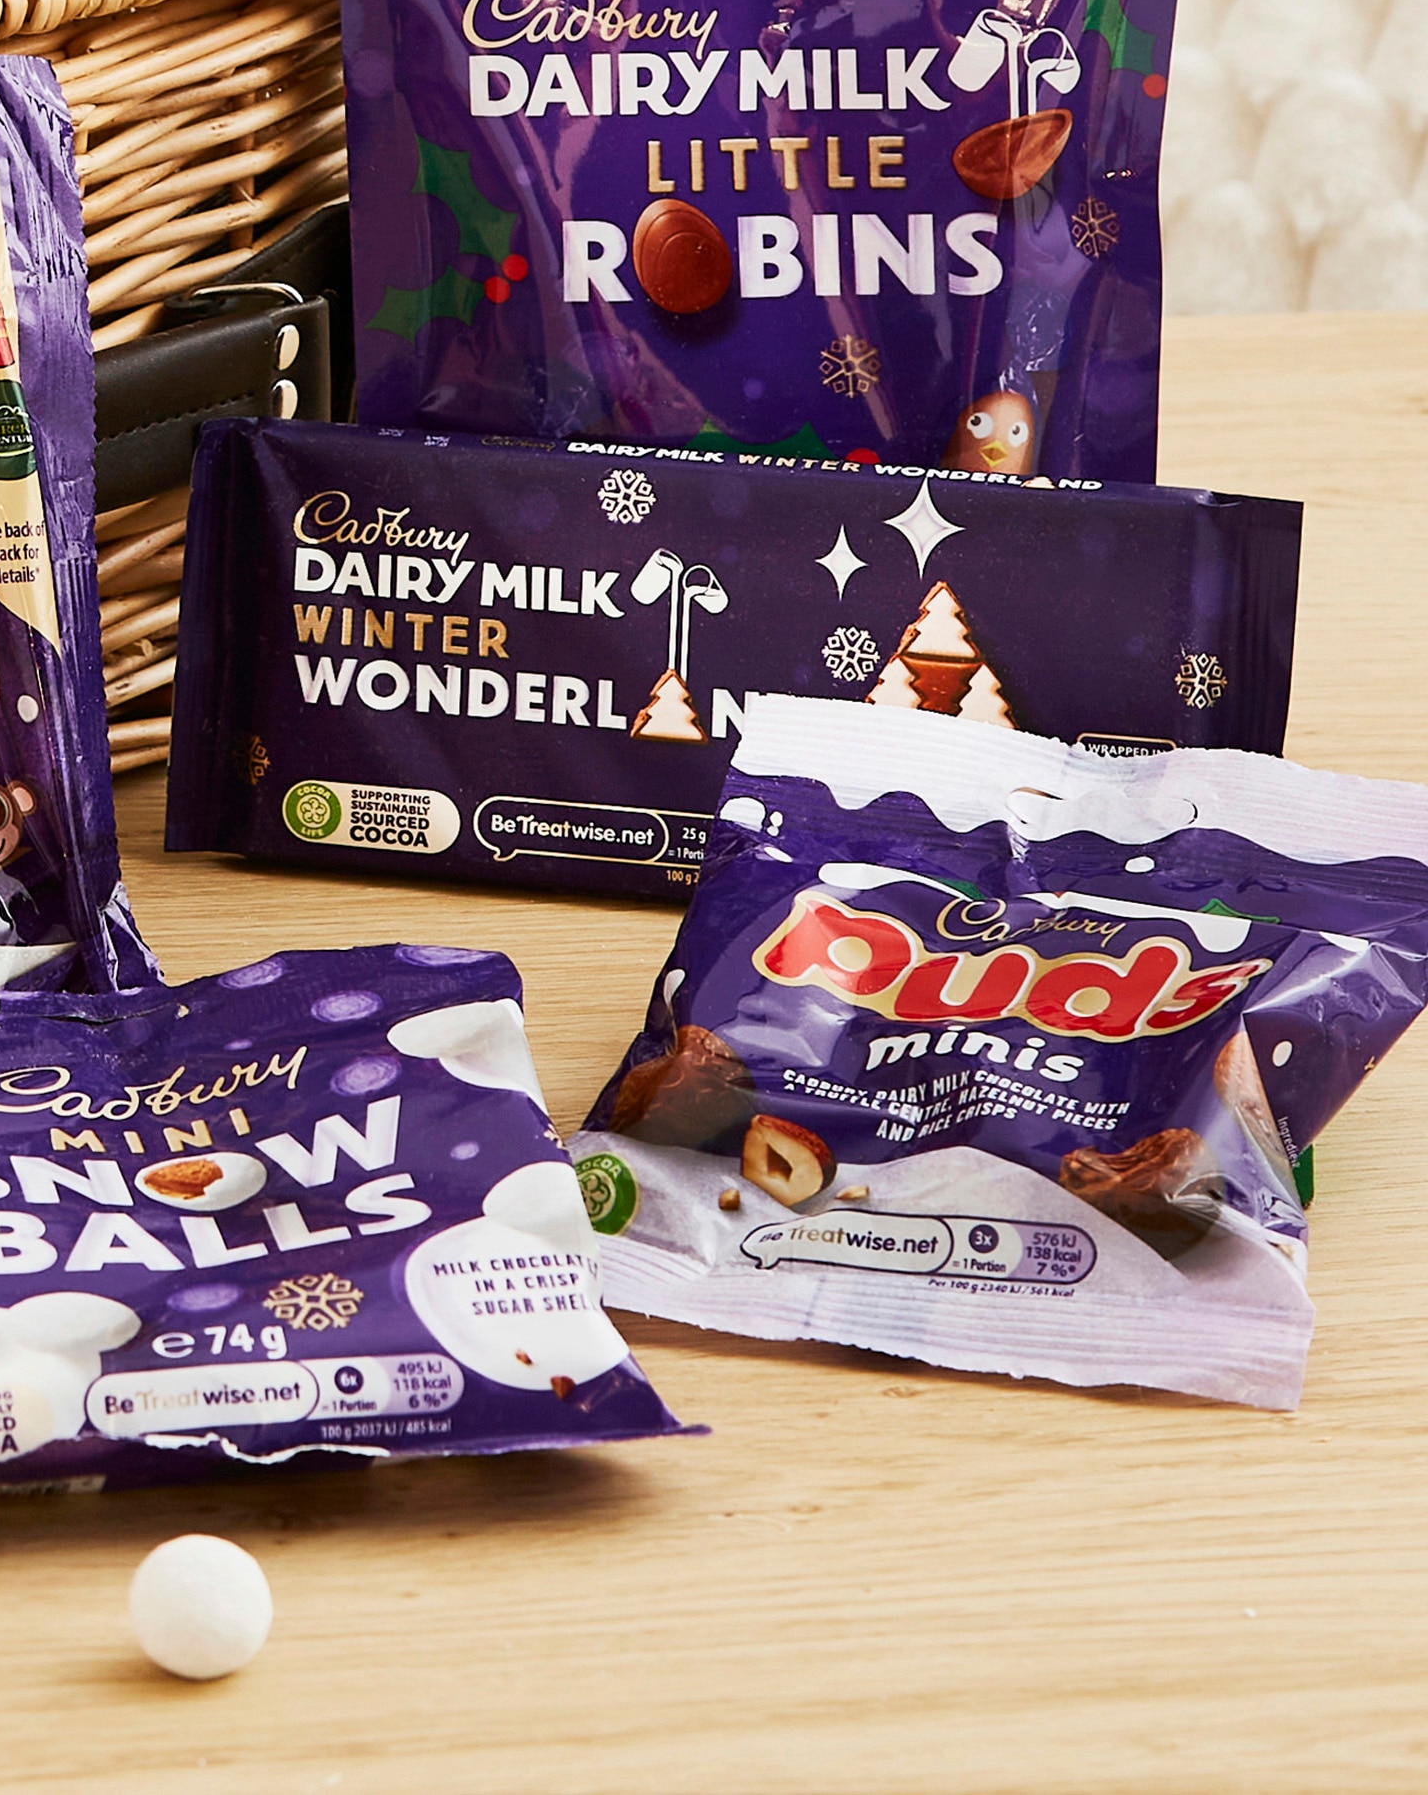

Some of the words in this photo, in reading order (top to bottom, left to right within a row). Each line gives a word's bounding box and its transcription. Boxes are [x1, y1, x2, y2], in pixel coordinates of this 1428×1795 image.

[469, 48, 729, 117] DAIRY
[739, 46, 951, 112] MILK
[647, 134, 907, 193] LITTLE
[566, 441, 656, 457] DAIRY
[655, 447, 725, 463] MILK
[739, 454, 862, 472] WINTER
[4, 521, 33, 538] back
[293, 490, 470, 564] Cadbury
[23, 543, 39, 559] for
[294, 548, 475, 603] DAIRY
[481, 563, 625, 618] MILK
[293, 604, 510, 659] WINTER
[351, 789, 431, 805] SUPPORTING
[351, 800, 430, 816] SUSTAINABLY
[351, 811, 430, 830] SOURCED
[350, 825, 429, 848] COCOA
[683, 848, 704, 860] Porti
[760, 896, 1271, 1039] Puds
[866, 1025, 1085, 1082] minis
[875, 1084, 926, 1104] DAIRY
[933, 1071, 970, 1097] MILK
[974, 1070, 1079, 1111] CHOCOLATE
[1084, 1101, 1131, 1116] WITH
[958, 1086, 1049, 1115] HAZELNUT
[1052, 1110, 1119, 1131] PIECES
[50, 1109, 251, 1153] MINI
[876, 1119, 916, 1143] AND
[919, 1118, 953, 1138] RICE
[956, 1102, 1018, 1125] CRISPS
[975, 1231, 993, 1246] 3x
[1033, 1231, 1058, 1246] 576
[1061, 1235, 1077, 1248] kJ
[1026, 1246, 1051, 1260] 138
[1053, 1248, 1082, 1263] kcal
[433, 1260, 482, 1277] MILK
[490, 1254, 598, 1276] CHOCOLAT
[970, 1259, 1006, 1273] Portion
[475, 1279, 495, 1293] IN
[505, 1278, 516, 1290] A
[524, 1273, 579, 1289] CRISP
[473, 1298, 535, 1316] SUGAR
[398, 1362, 424, 1375] 495
[394, 1378, 418, 1391] 118
[421, 1375, 452, 1390] kcal
[105, 1394, 134, 1415] Be
[429, 1420, 451, 1434] kcal
